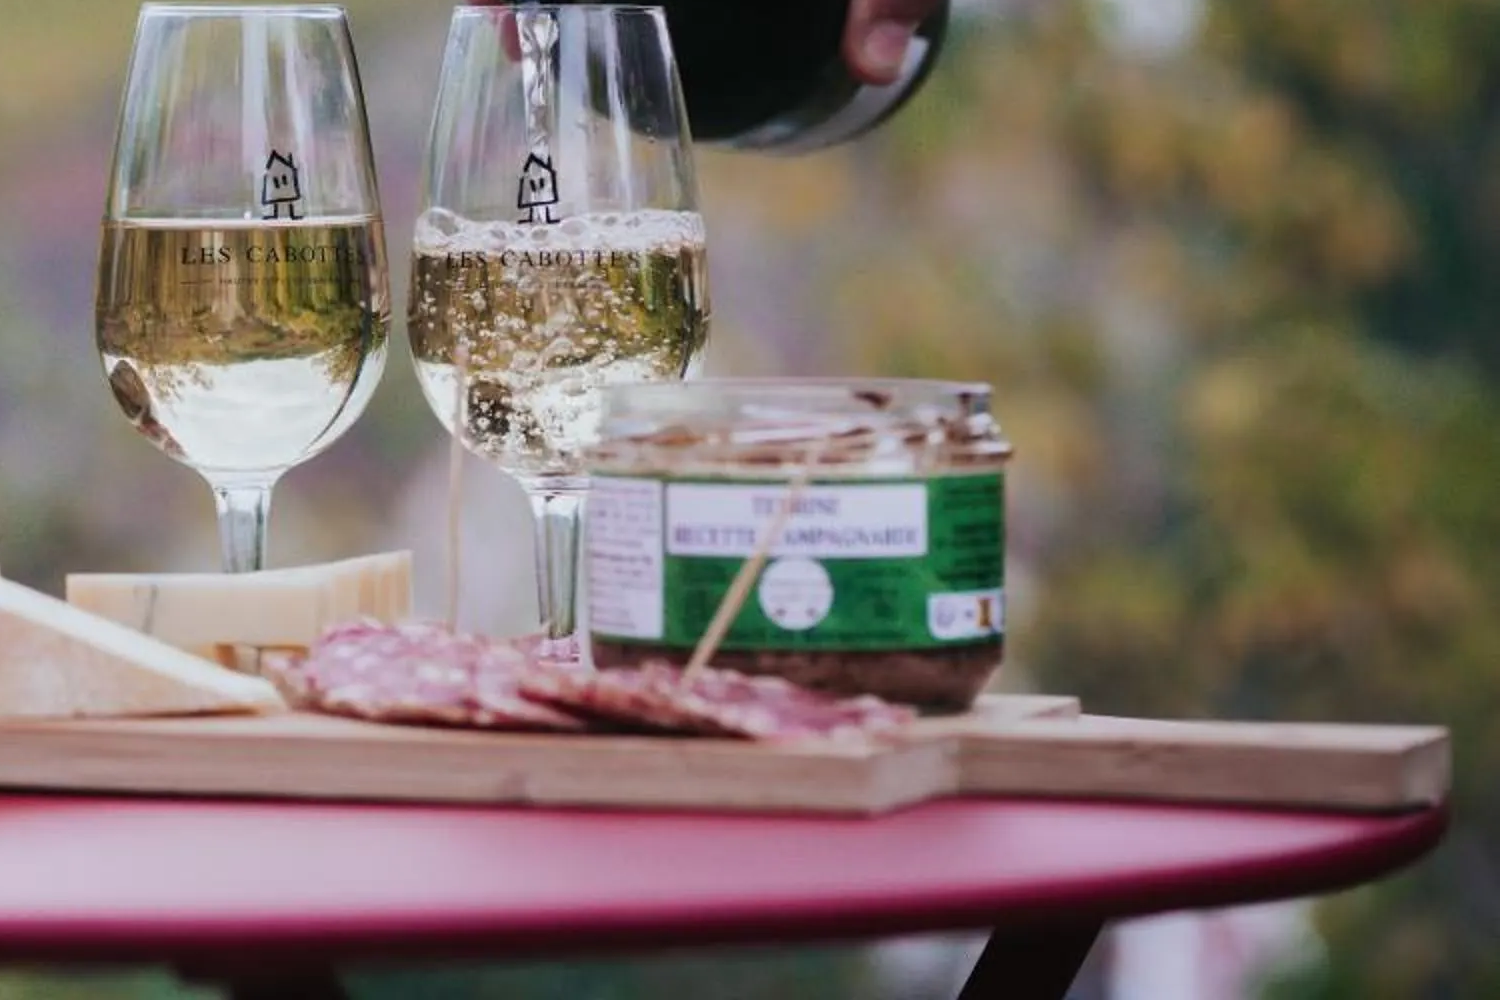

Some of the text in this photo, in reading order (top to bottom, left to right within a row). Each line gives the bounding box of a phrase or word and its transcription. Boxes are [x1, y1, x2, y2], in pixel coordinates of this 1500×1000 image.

[181, 247, 231, 265] LES
[446, 249, 641, 268] LES CABOTTES
